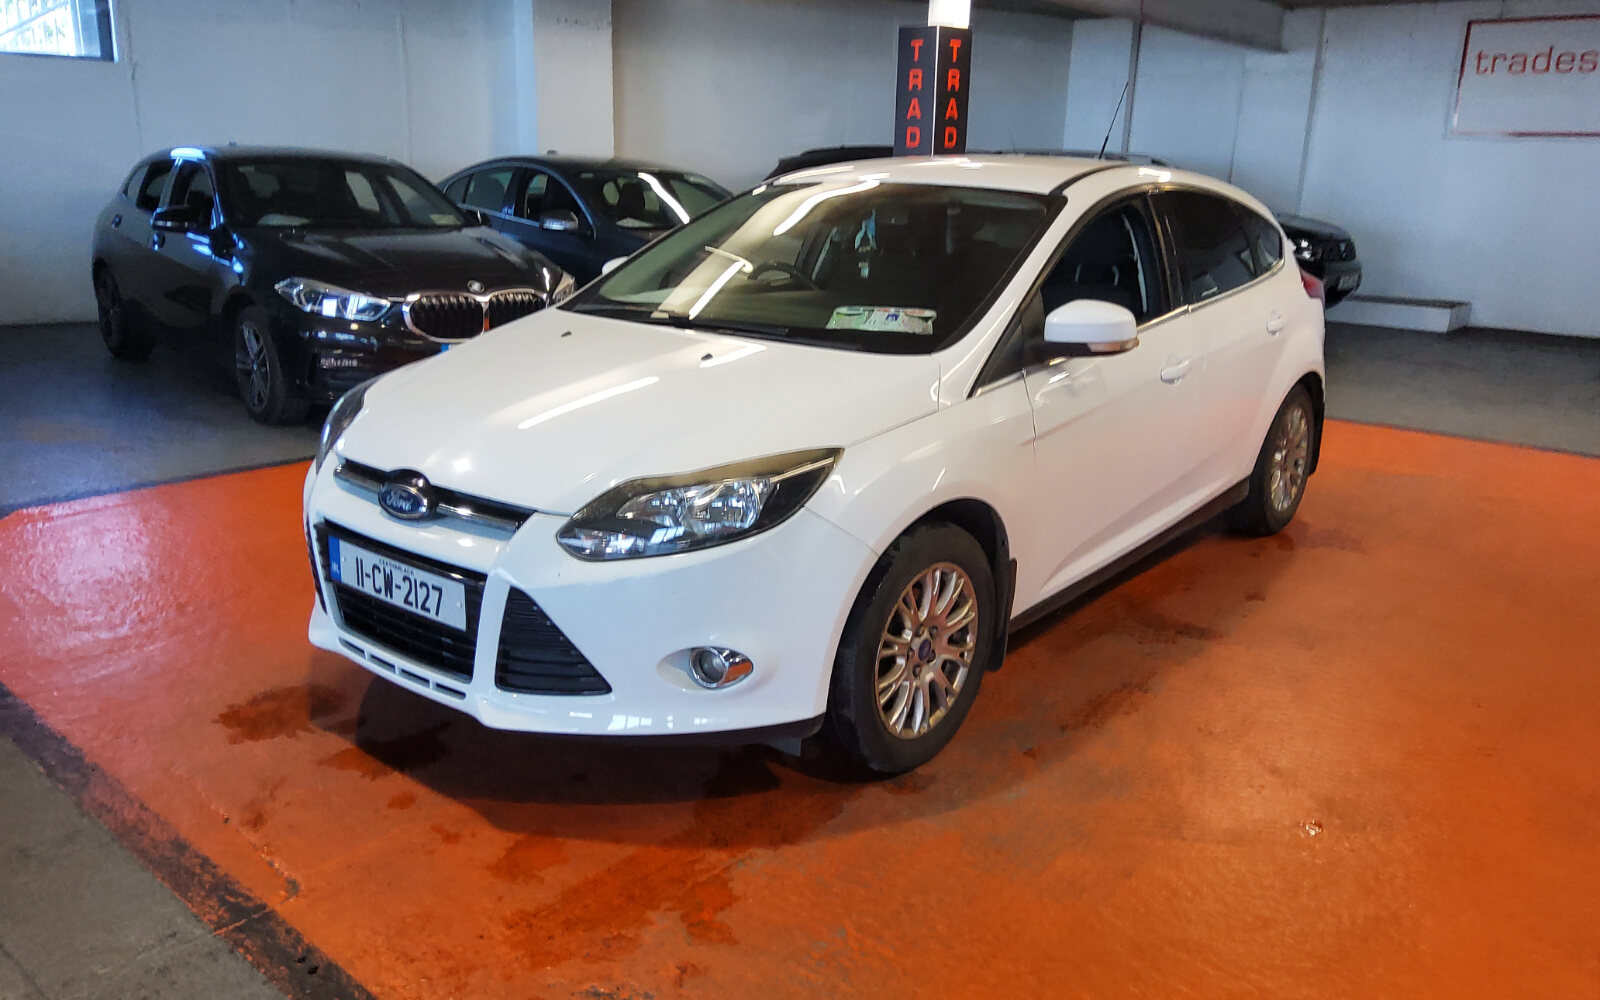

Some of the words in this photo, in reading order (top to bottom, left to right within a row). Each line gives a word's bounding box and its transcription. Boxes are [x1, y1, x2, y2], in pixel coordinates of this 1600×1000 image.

[1475, 45, 1600, 75] trades
[905, 38, 924, 158] TRAD
[944, 38, 962, 158] TRAD
[386, 490, 412, 511] Ford
[355, 556, 443, 617] 11-CW-2127
